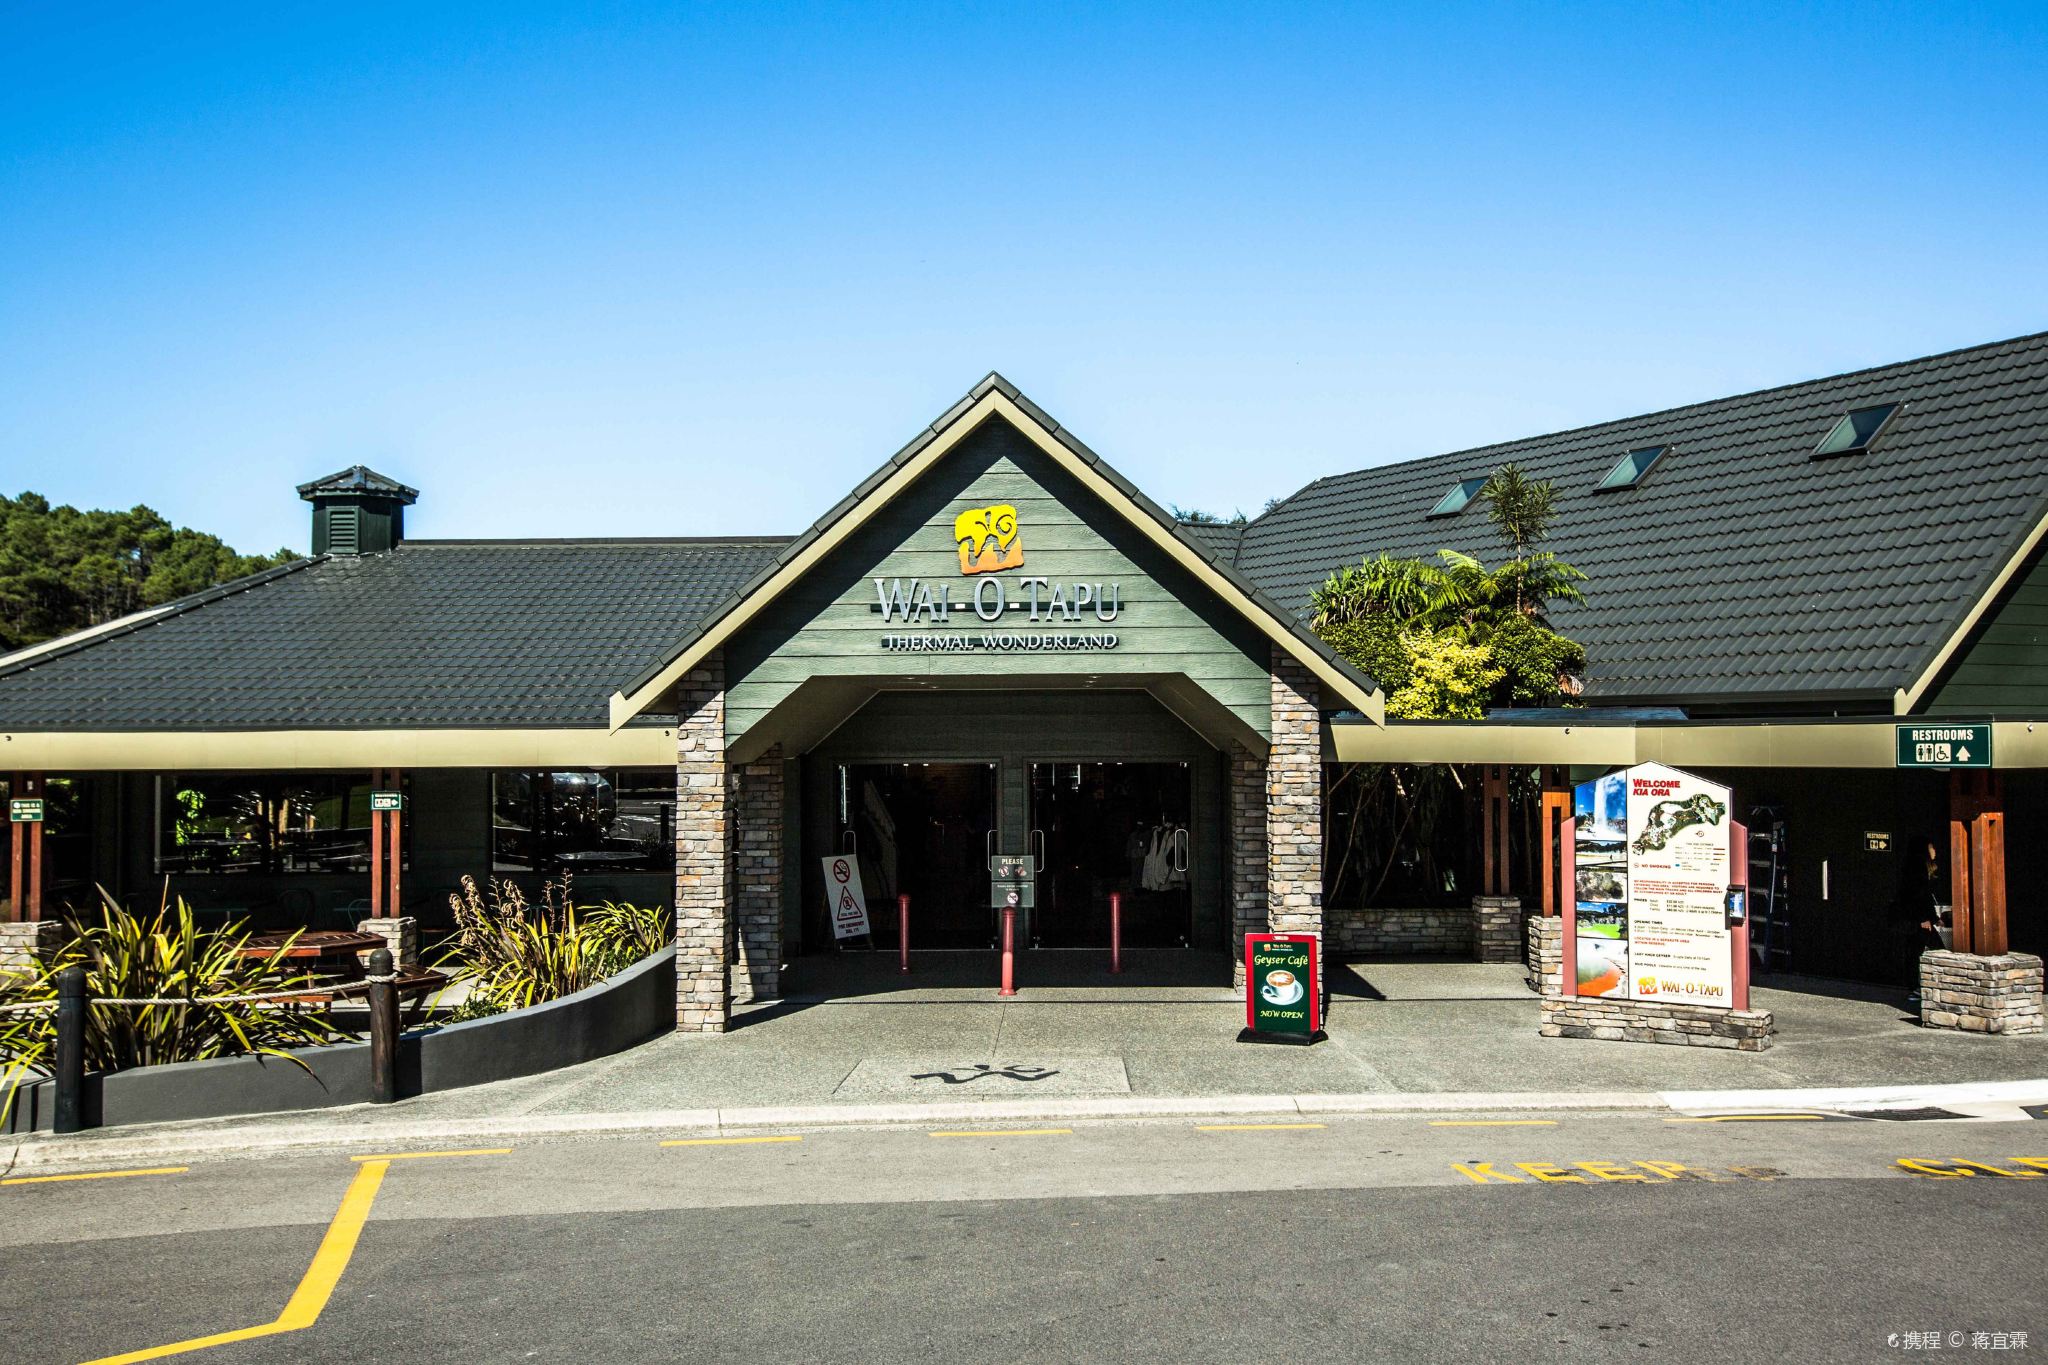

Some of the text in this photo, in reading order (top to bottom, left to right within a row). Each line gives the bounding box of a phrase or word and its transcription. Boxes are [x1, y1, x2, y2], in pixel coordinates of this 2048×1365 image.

[884, 633, 1118, 650] THERMAL WONDERLAND
[1912, 729, 1974, 741] RESTROOMS
[1632, 779, 1680, 788] WELCOME
[1632, 788, 1670, 796] KIA ORA
[1254, 955, 1308, 968] Geyser Café
[1450, 1160, 1687, 1183] KEEP
